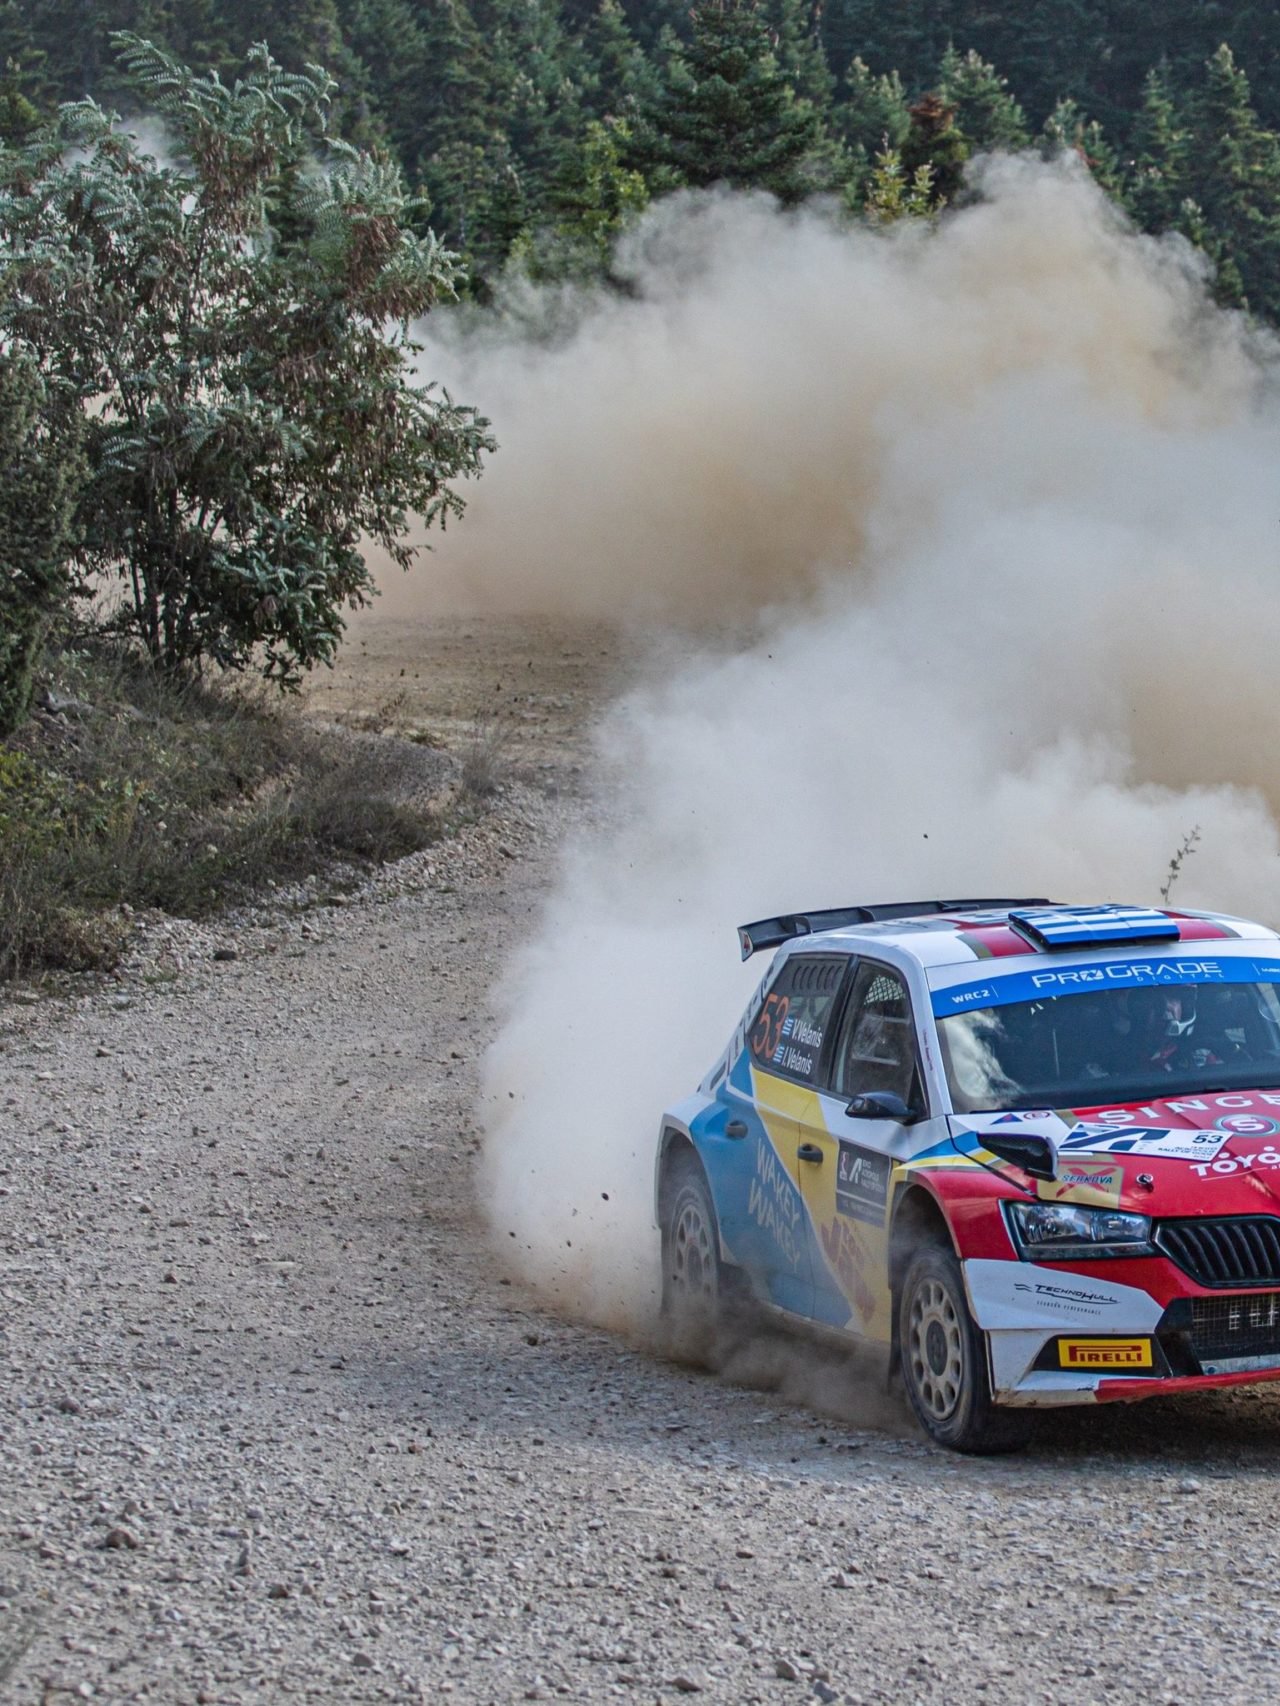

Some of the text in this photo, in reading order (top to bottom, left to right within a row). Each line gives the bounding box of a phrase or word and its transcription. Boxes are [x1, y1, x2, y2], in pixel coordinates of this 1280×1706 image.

[1137, 973, 1224, 983] DIGITAL
[952, 989, 991, 1004] WRC2
[753, 993, 789, 1058] 53
[1192, 1134, 1224, 1144] 53
[756, 1138, 800, 1230] WAKEY
[1035, 1284, 1118, 1303] TECHNOHULL
[1068, 1345, 1143, 1363] PIRELLI
